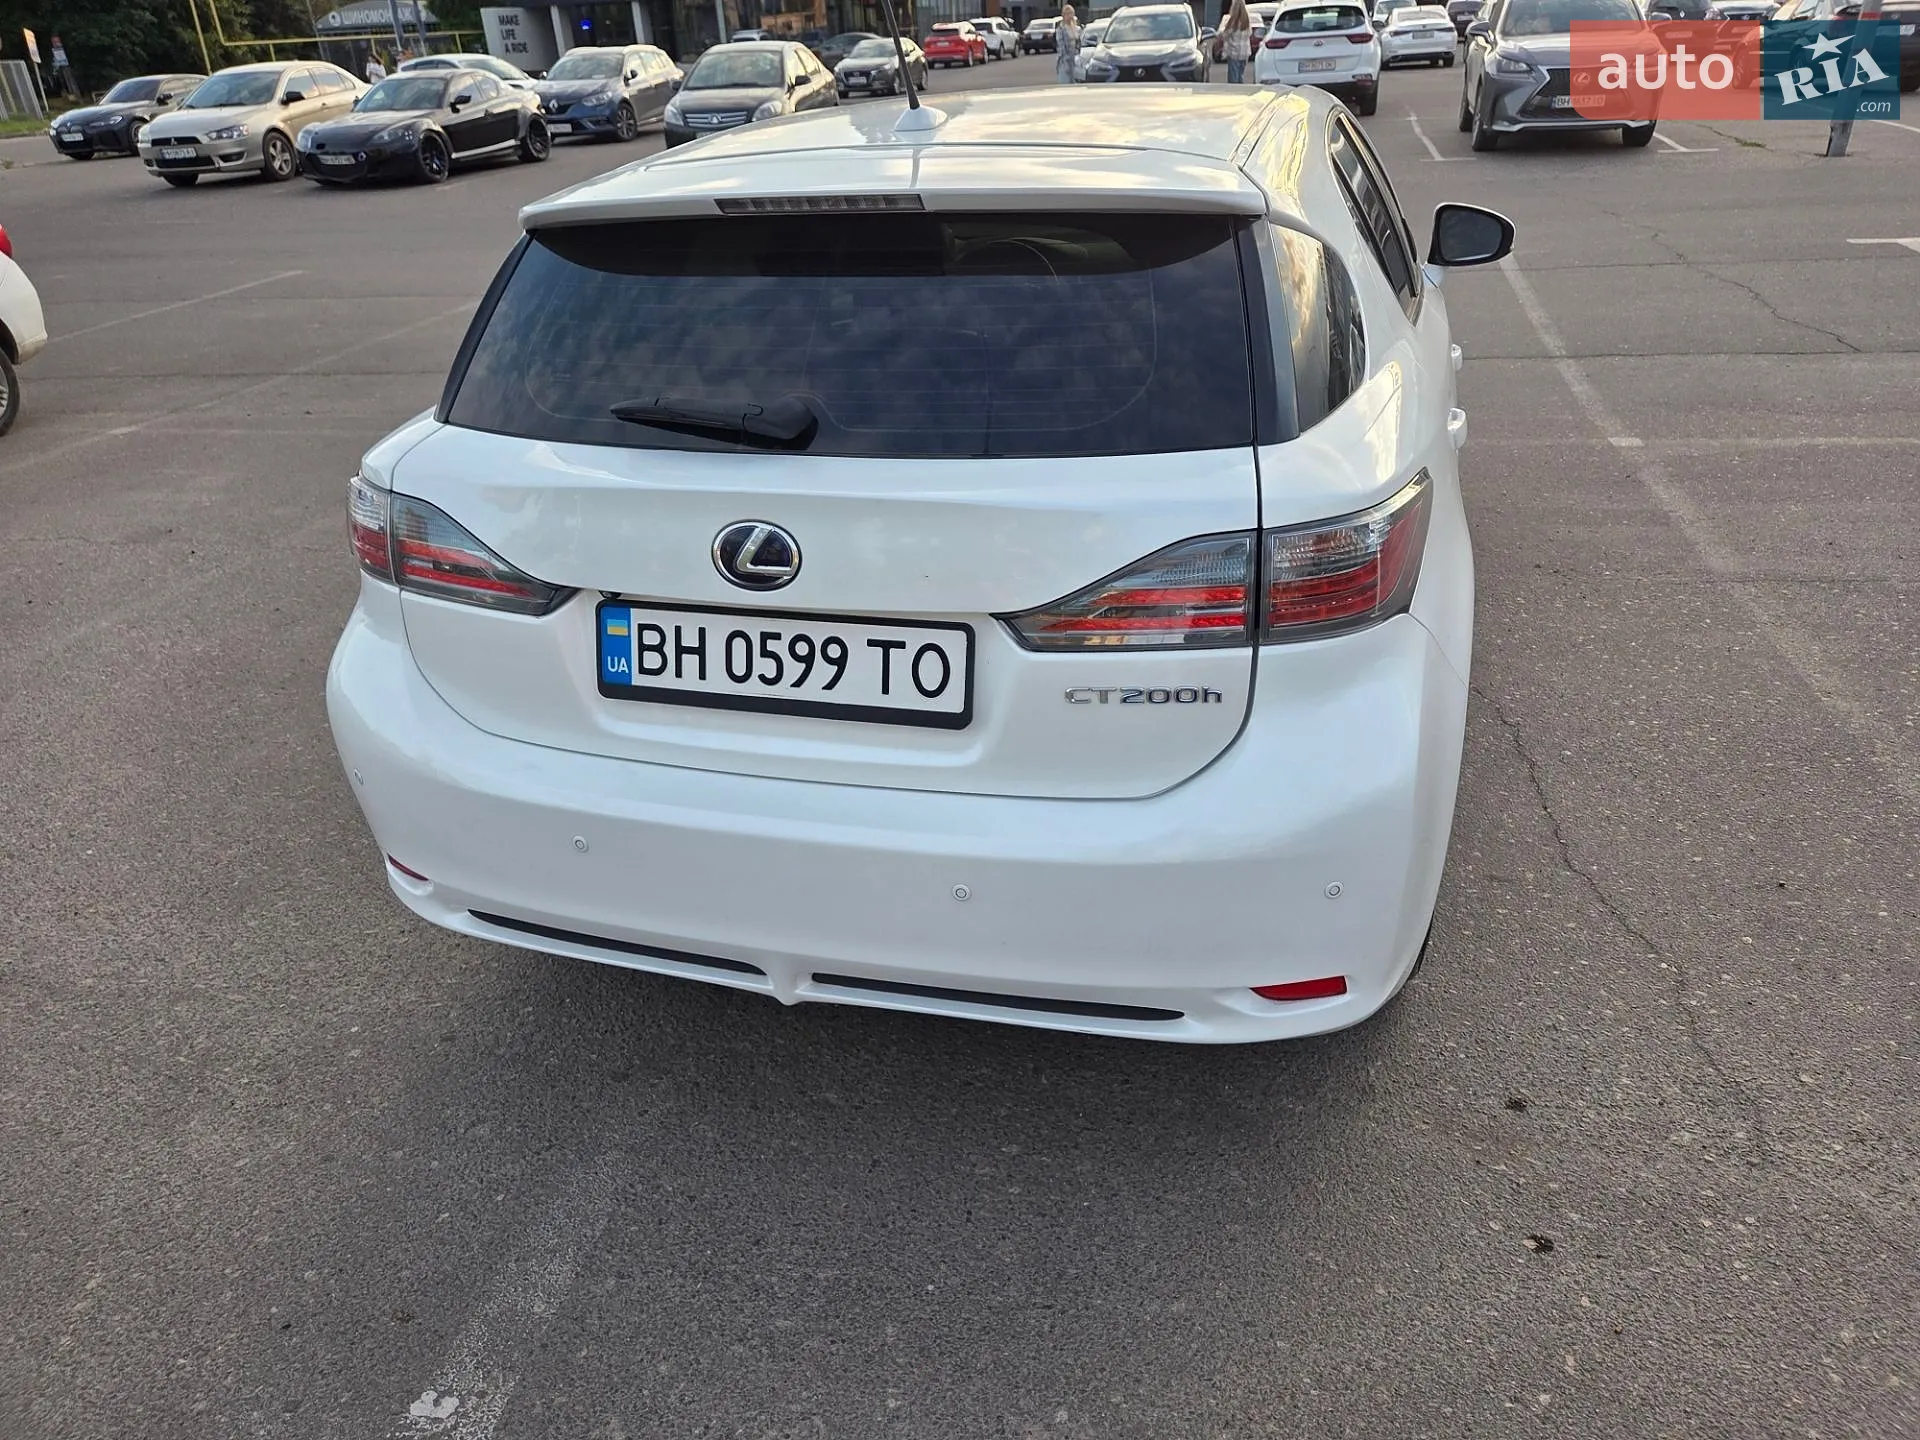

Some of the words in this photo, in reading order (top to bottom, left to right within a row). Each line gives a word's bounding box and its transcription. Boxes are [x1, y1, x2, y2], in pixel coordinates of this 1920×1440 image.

[340, 7, 416, 25] ШИНОМОНАЖ
[498, 14, 521, 27] MAKE
[500, 28, 517, 41] LIFE
[511, 42, 529, 54] RIDE
[607, 656, 629, 674] UA
[637, 623, 707, 681] BH
[724, 629, 849, 691] 0599
[866, 638, 951, 699] TO
[1065, 685, 1223, 705] CT200h
